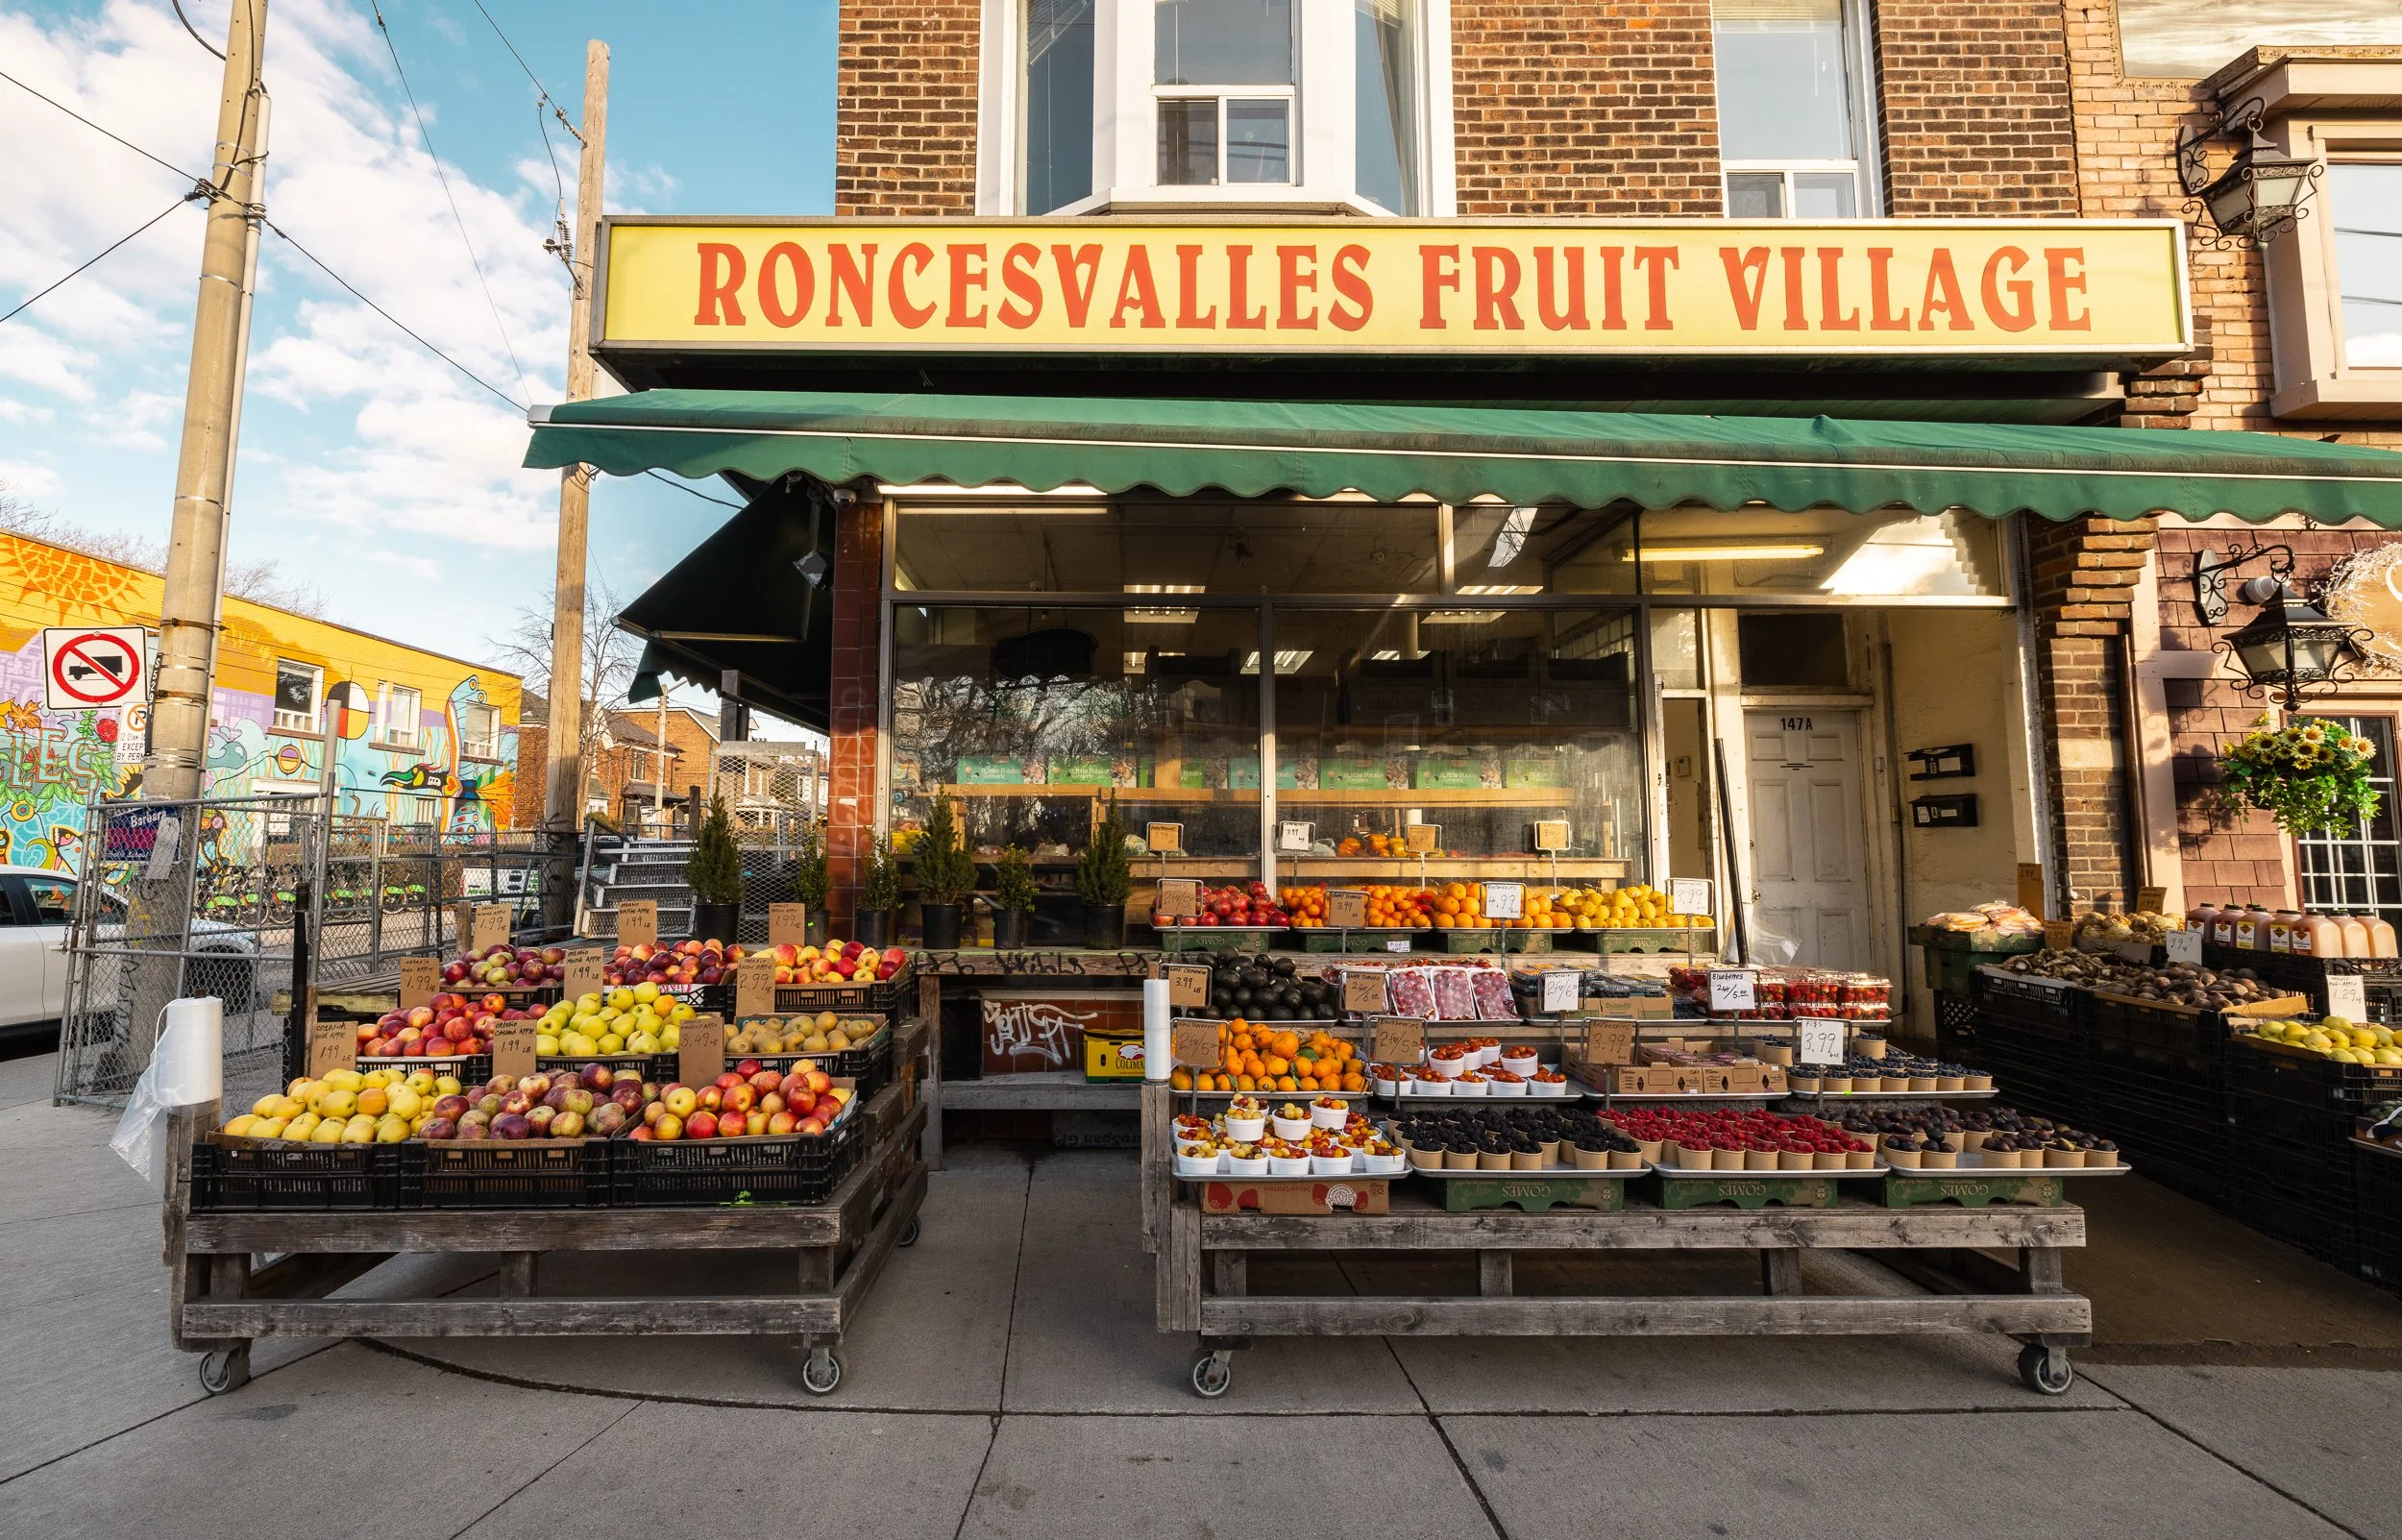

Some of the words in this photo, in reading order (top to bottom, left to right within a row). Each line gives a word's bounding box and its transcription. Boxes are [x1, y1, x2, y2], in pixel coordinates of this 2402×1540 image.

[693, 241, 1375, 332] RONCESVALLES
[1418, 244, 1679, 331] FRUIT
[1718, 245, 2093, 332] VILLAGE
[1779, 717, 1814, 731] 147A
[121, 743, 144, 751] EXCEP
[131, 810, 167, 828] Barbara
[573, 966, 591, 979] 1.99
[406, 976, 431, 990] 1.99
[739, 974, 770, 990] 2.99
[1175, 977, 1193, 989] 3.99
[501, 1040, 520, 1053] 1.99
[1593, 1033, 1626, 1054] 3.99
[1804, 1032, 1836, 1054] 3.99
[1115, 1057, 1145, 1069] COLIMA
[1502, 1186, 1551, 1198] GOMES
[1718, 1185, 1766, 1196] GOMES
[1941, 1185, 1989, 1196] GOMES
